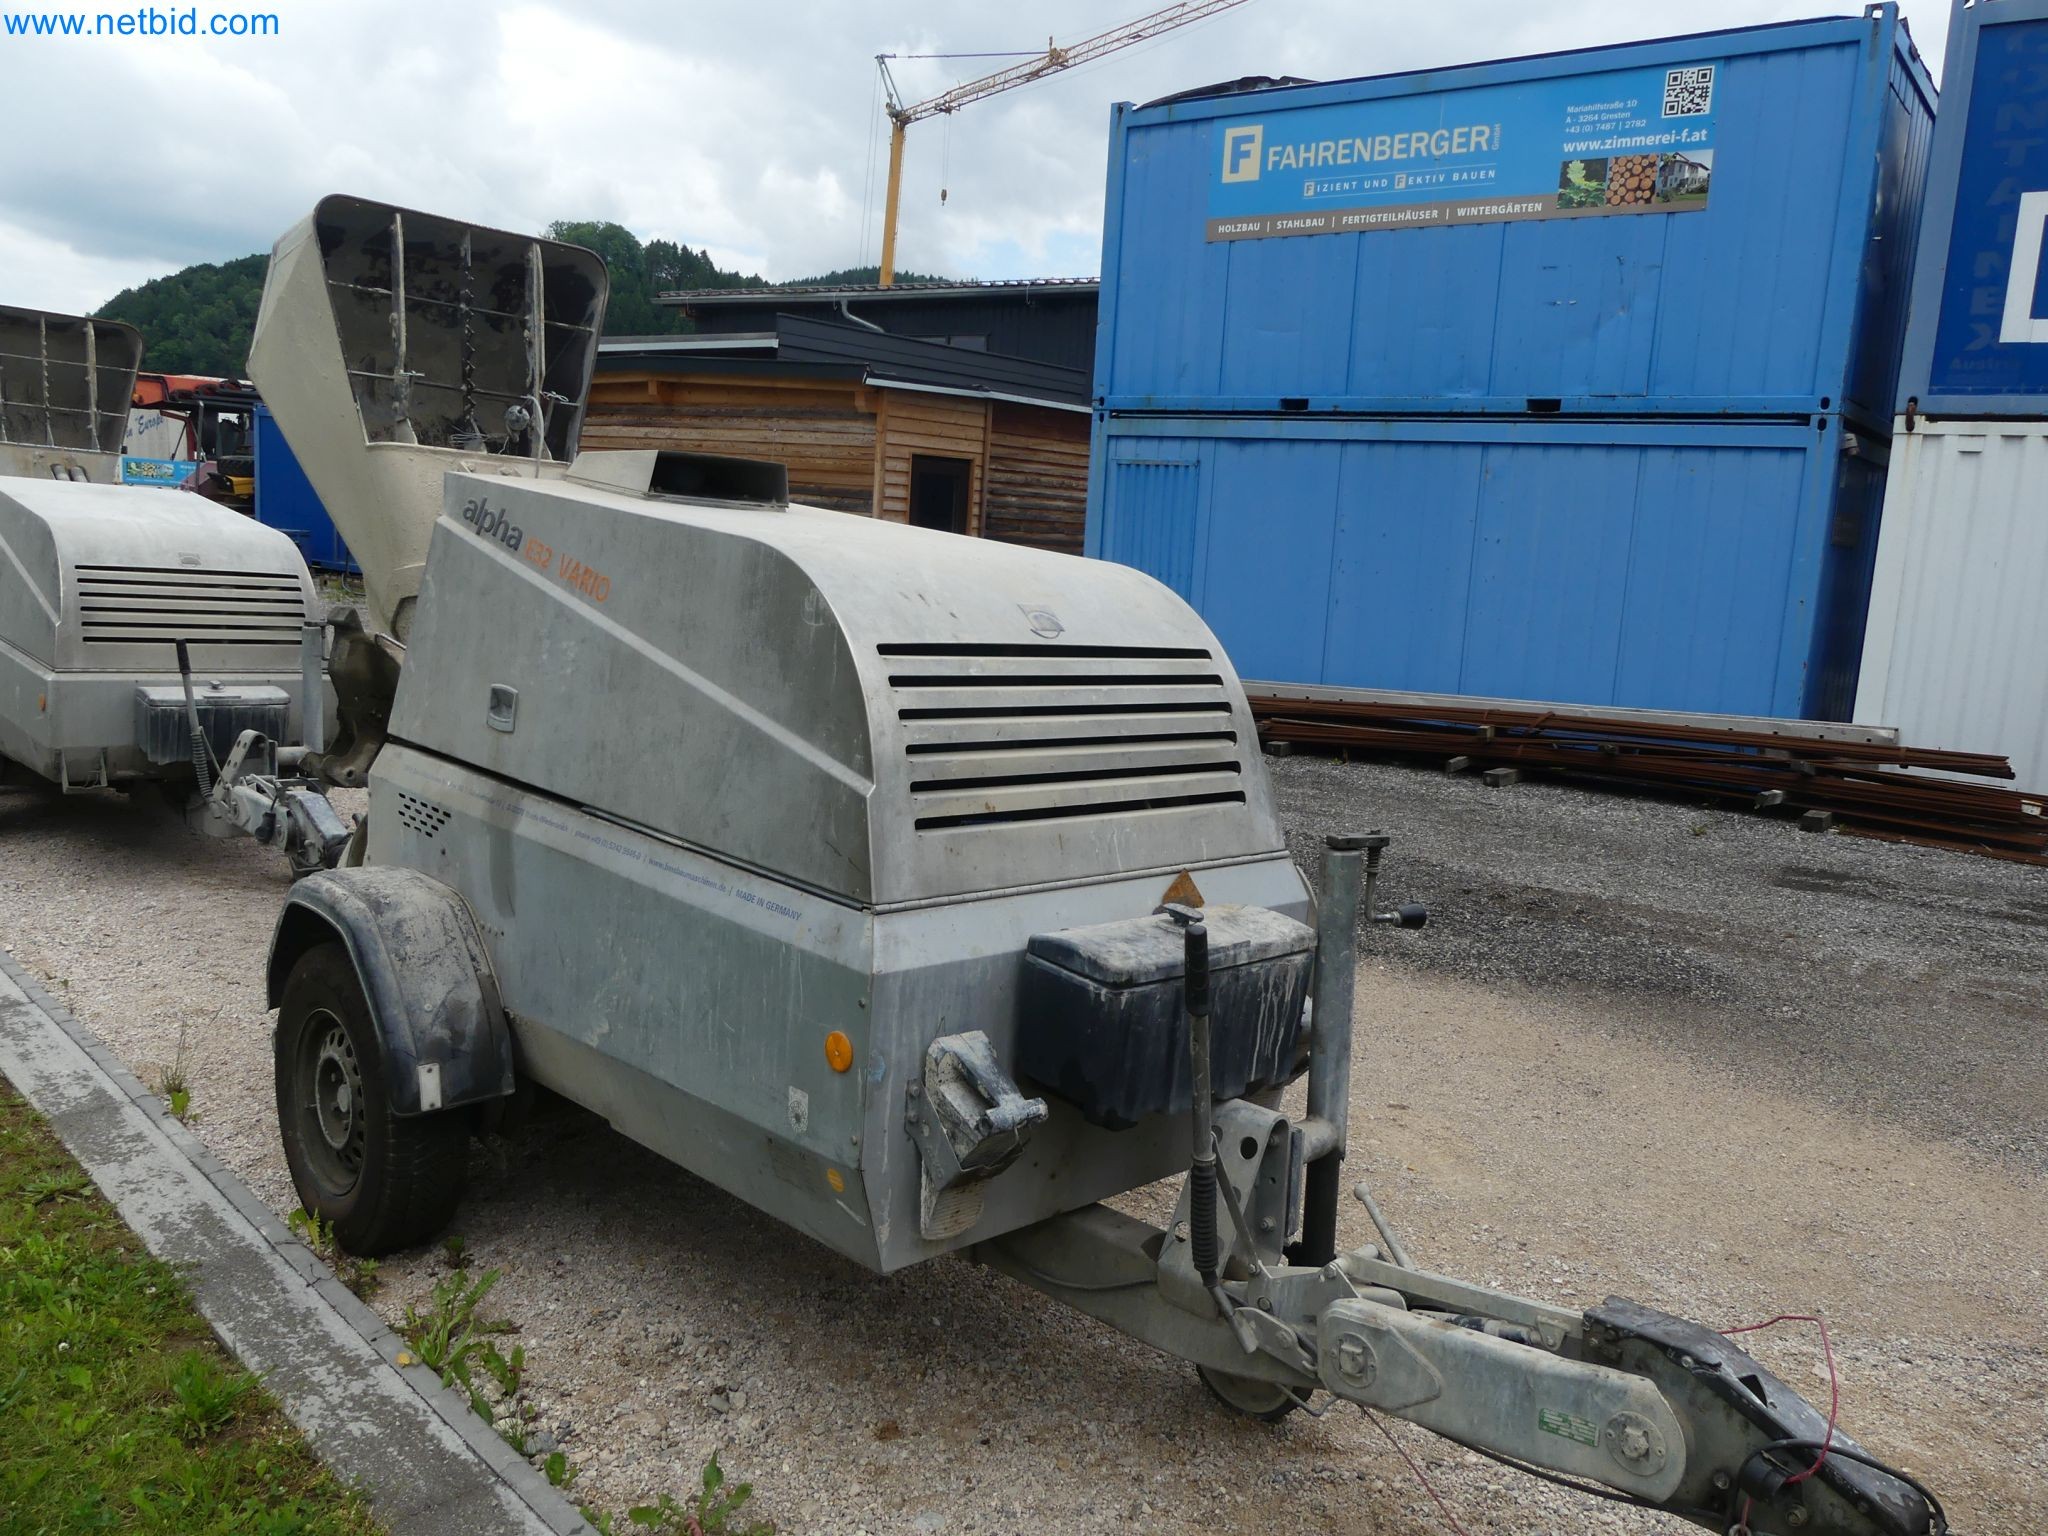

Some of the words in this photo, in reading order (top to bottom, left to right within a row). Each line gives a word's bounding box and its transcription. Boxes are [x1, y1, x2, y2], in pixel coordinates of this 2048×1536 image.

[1626, 99, 1638, 108] 10
[1563, 128, 1709, 153] www.zimmerei-f.at
[1565, 125, 1580, 133] +43
[1582, 124, 1593, 133] (0)
[1267, 125, 1490, 171] FAHRENBERGER
[1364, 178, 1388, 189] UND
[1452, 169, 1496, 182] BAUEN
[1218, 222, 1260, 233] HOLZBAU
[1276, 217, 1325, 230] STAHLBAU
[1342, 208, 1439, 225] FERTIGTEILHÄUSER
[1457, 202, 1543, 217] WINTERGÄRTEN
[462, 496, 524, 552] alpha
[559, 552, 612, 603] VARIO
[735, 888, 757, 904] MADE
[765, 900, 802, 921] GERMANY
